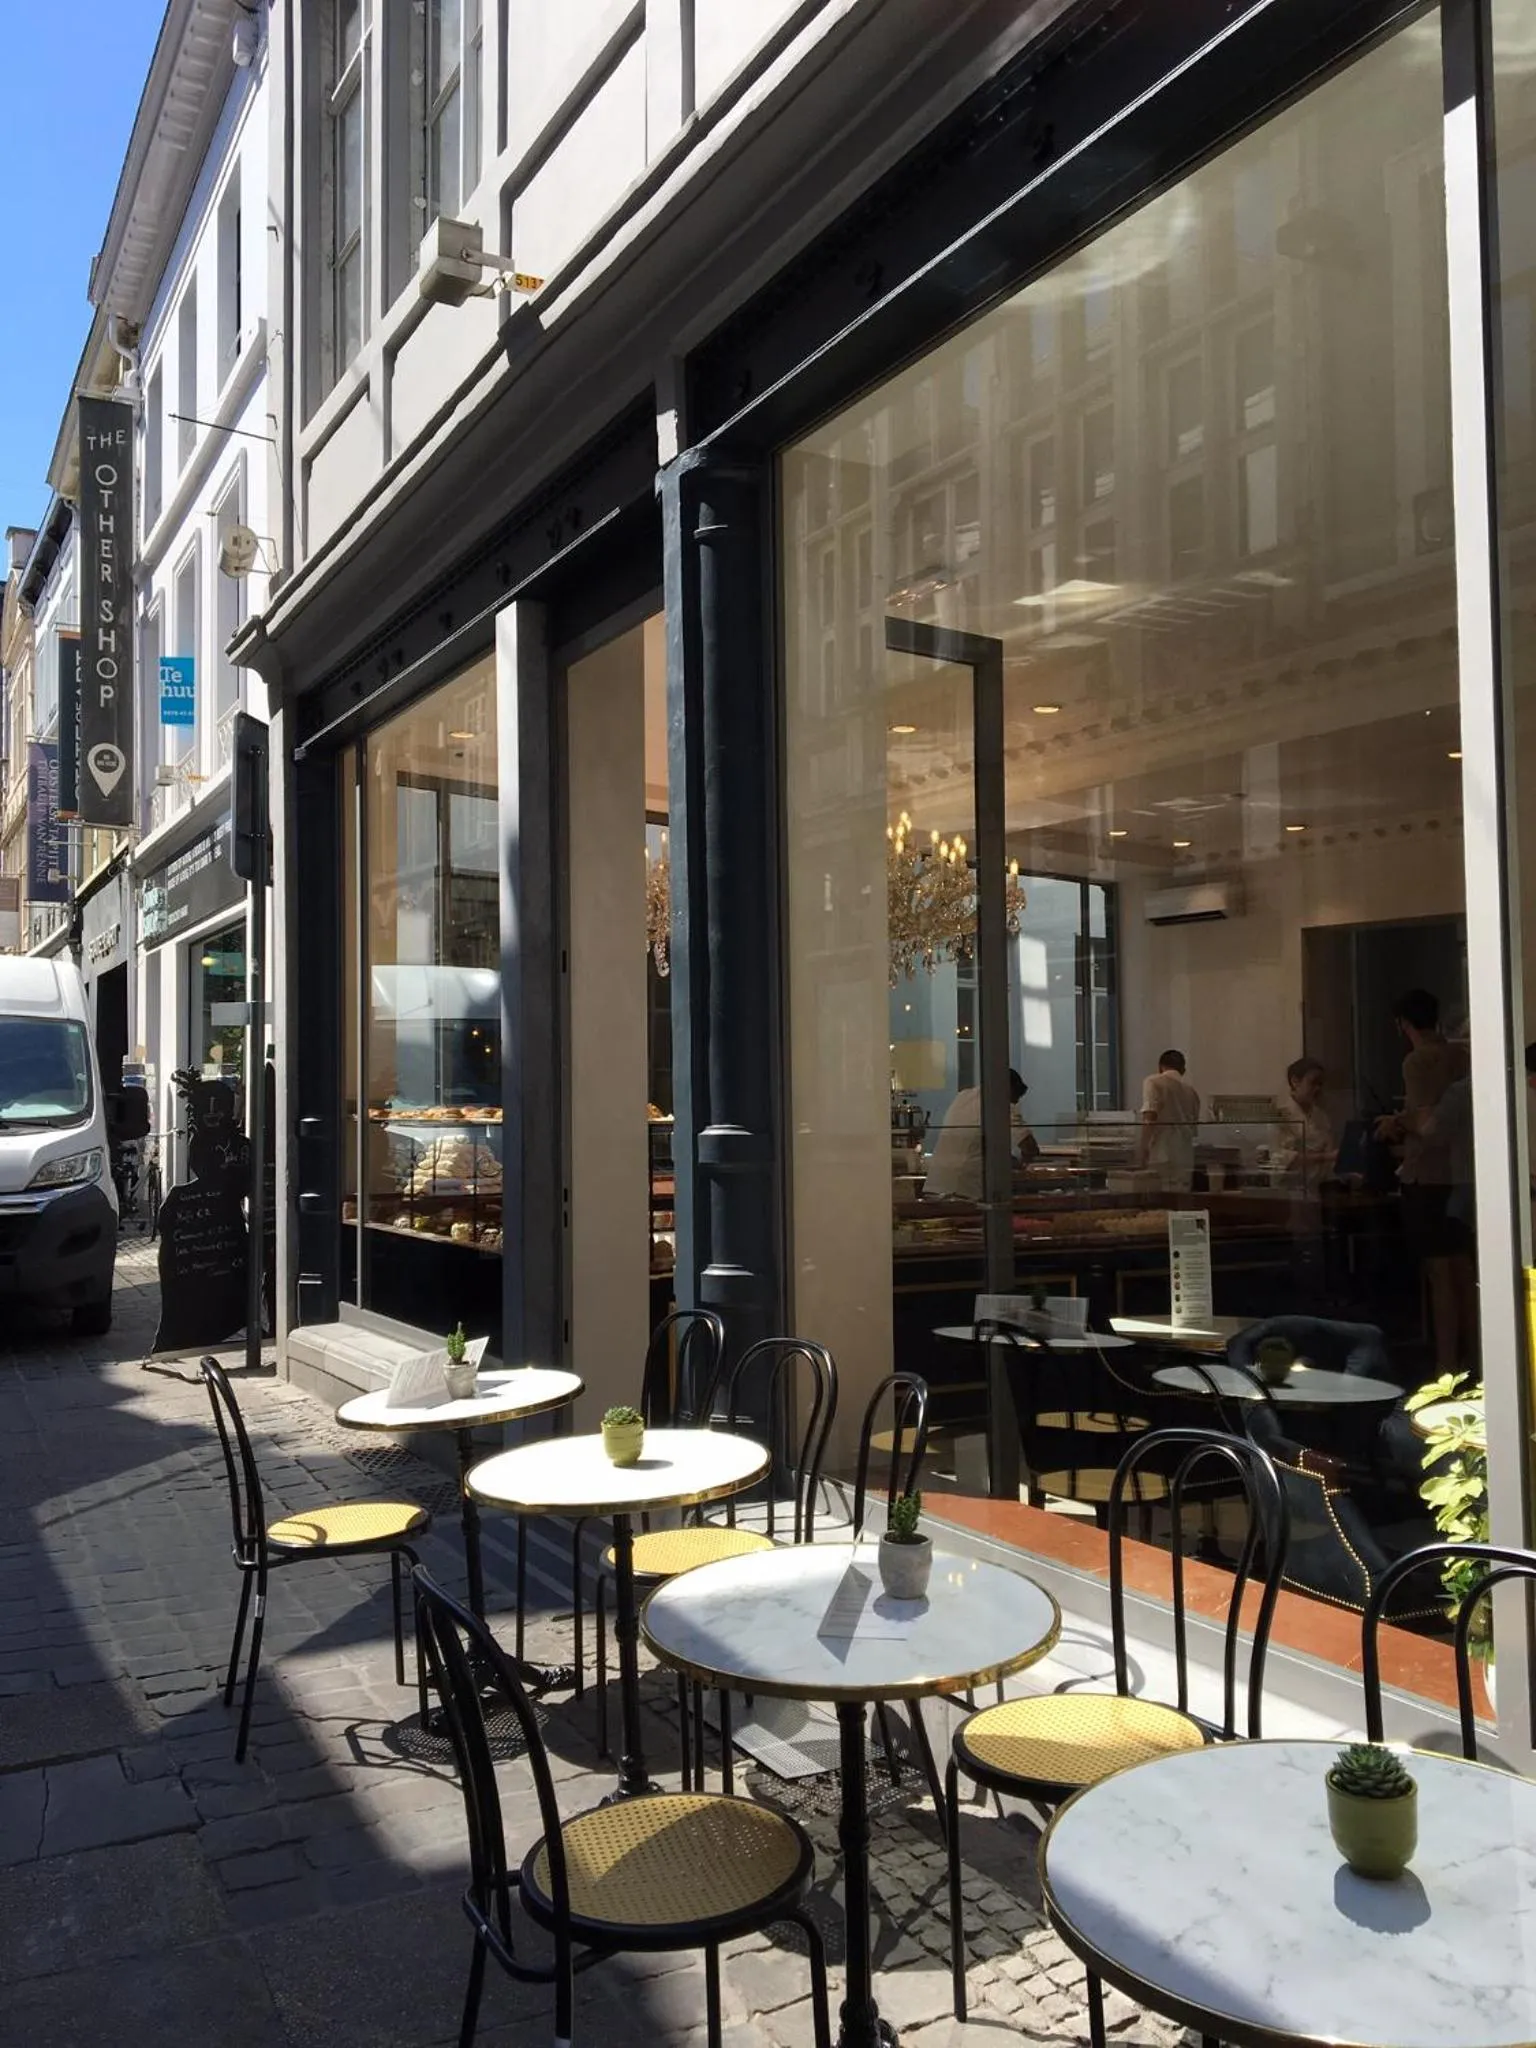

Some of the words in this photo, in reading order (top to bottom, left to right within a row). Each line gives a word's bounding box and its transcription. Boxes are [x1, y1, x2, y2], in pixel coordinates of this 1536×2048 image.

[87, 429, 126, 451] THE
[95, 464, 118, 583] OTHER
[96, 600, 118, 708] SHOP
[160, 666, 182, 683] Te
[160, 682, 195, 698] huu
